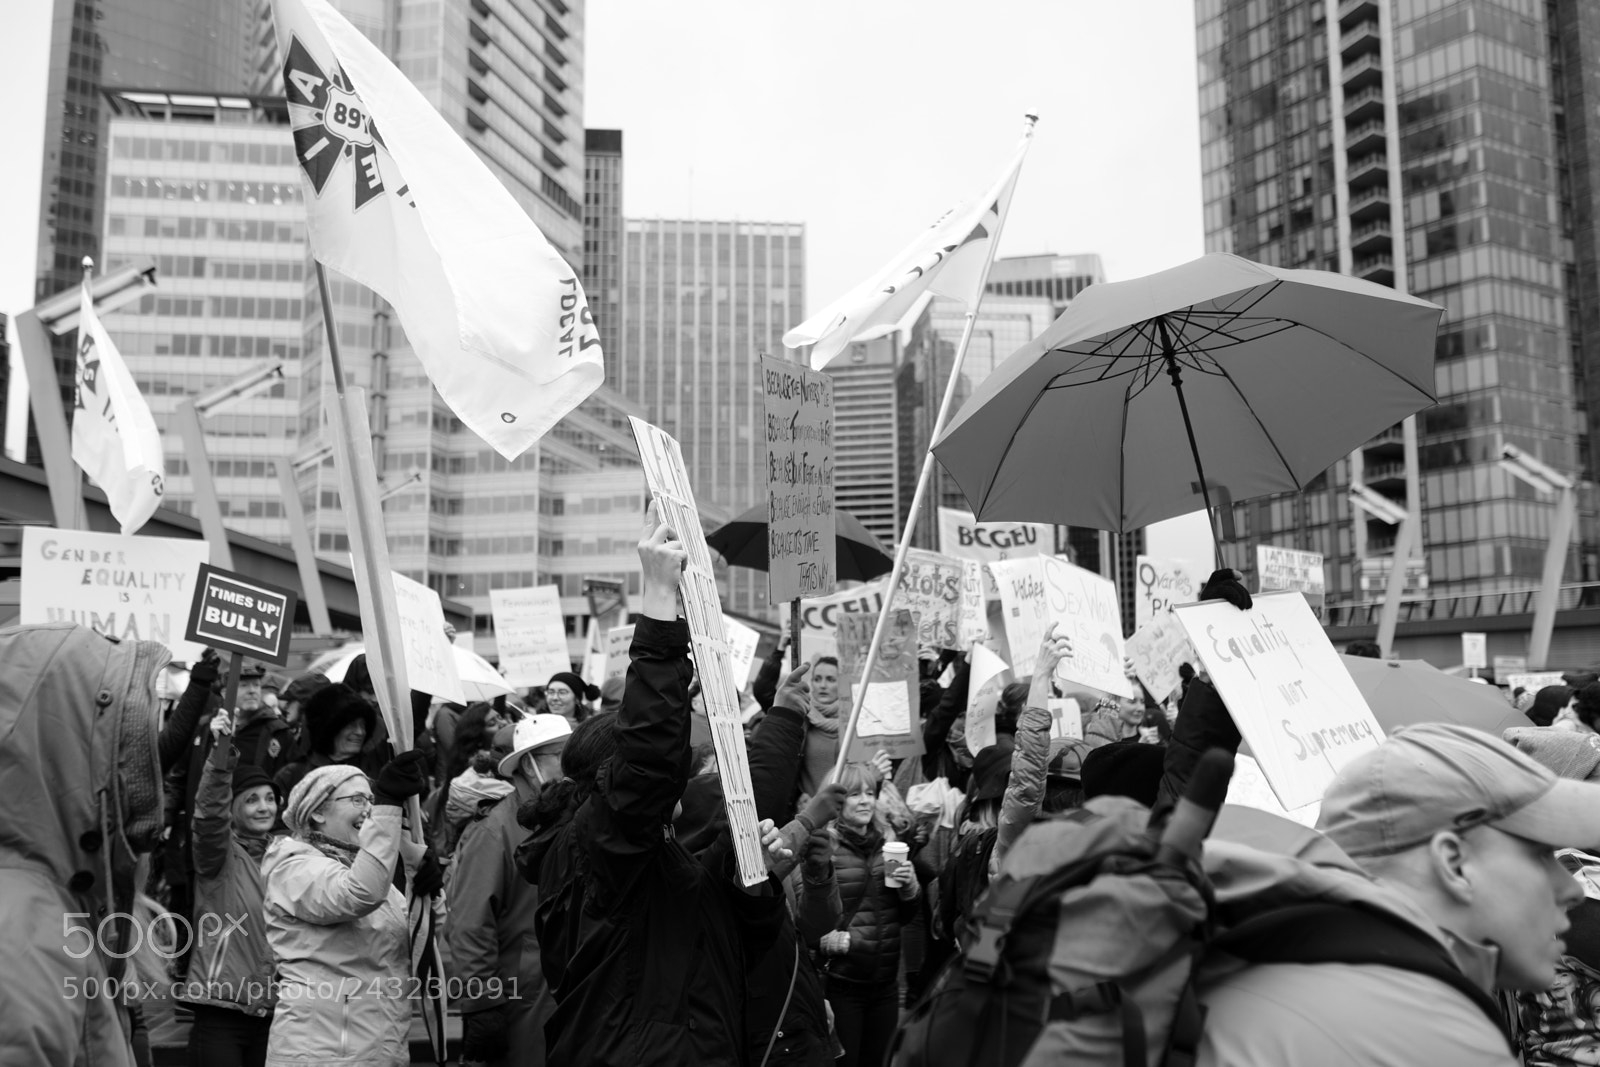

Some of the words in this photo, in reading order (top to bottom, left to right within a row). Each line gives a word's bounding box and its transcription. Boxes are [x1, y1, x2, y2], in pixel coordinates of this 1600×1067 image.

[957, 524, 1037, 549] BCGEU
[40, 539, 126, 565] GENDER
[81, 568, 186, 591] EQUALITY
[119, 591, 130, 603] IS
[144, 592, 154, 605] A
[209, 585, 254, 608] TIMES
[256, 600, 281, 617] UP!
[204, 604, 278, 640] BULLY
[1205, 614, 1304, 681] Equality
[1278, 679, 1308, 706] NOT
[1281, 718, 1381, 776] Supremacy
